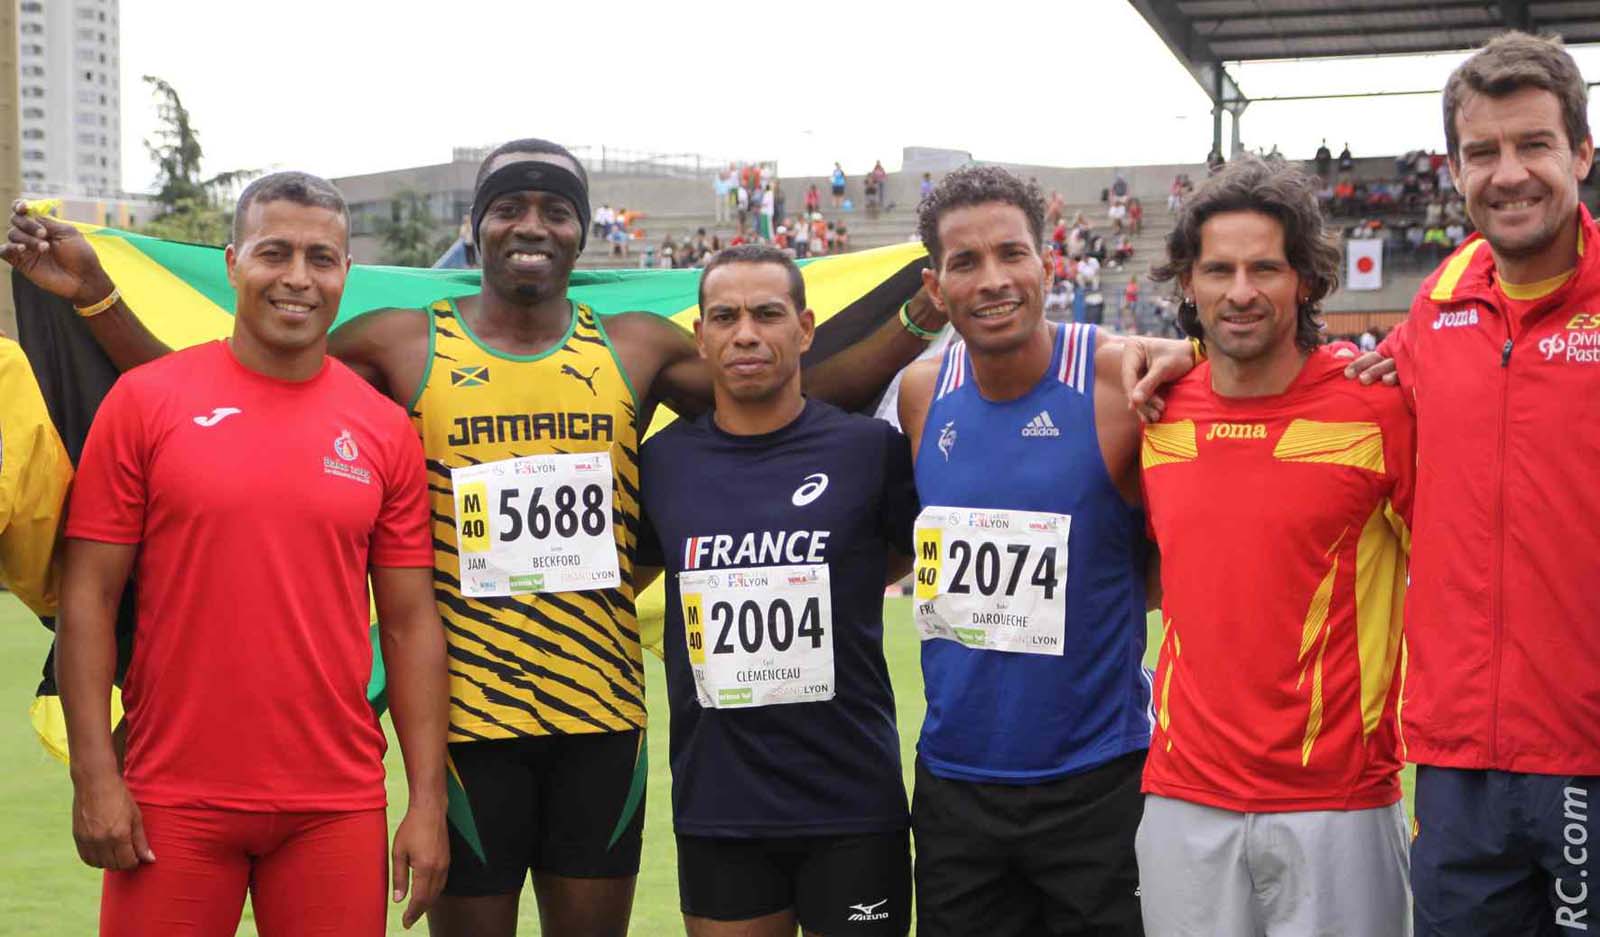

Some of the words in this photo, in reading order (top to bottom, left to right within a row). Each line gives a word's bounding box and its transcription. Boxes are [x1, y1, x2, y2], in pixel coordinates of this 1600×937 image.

[448, 412, 613, 446] JAMAICA
[1022, 427, 1060, 437] adidas
[464, 494, 481, 513] M
[499, 484, 606, 542] 5688
[462, 520, 485, 538] 40
[694, 530, 831, 569] FRANCE
[923, 541, 937, 561] M
[468, 558, 487, 570] JAM
[532, 554, 581, 568] BECKFORD
[947, 540, 1058, 600] 2074
[918, 567, 937, 585] 40
[688, 606, 699, 625] M
[711, 597, 824, 654] 2004
[690, 632, 702, 650] 40
